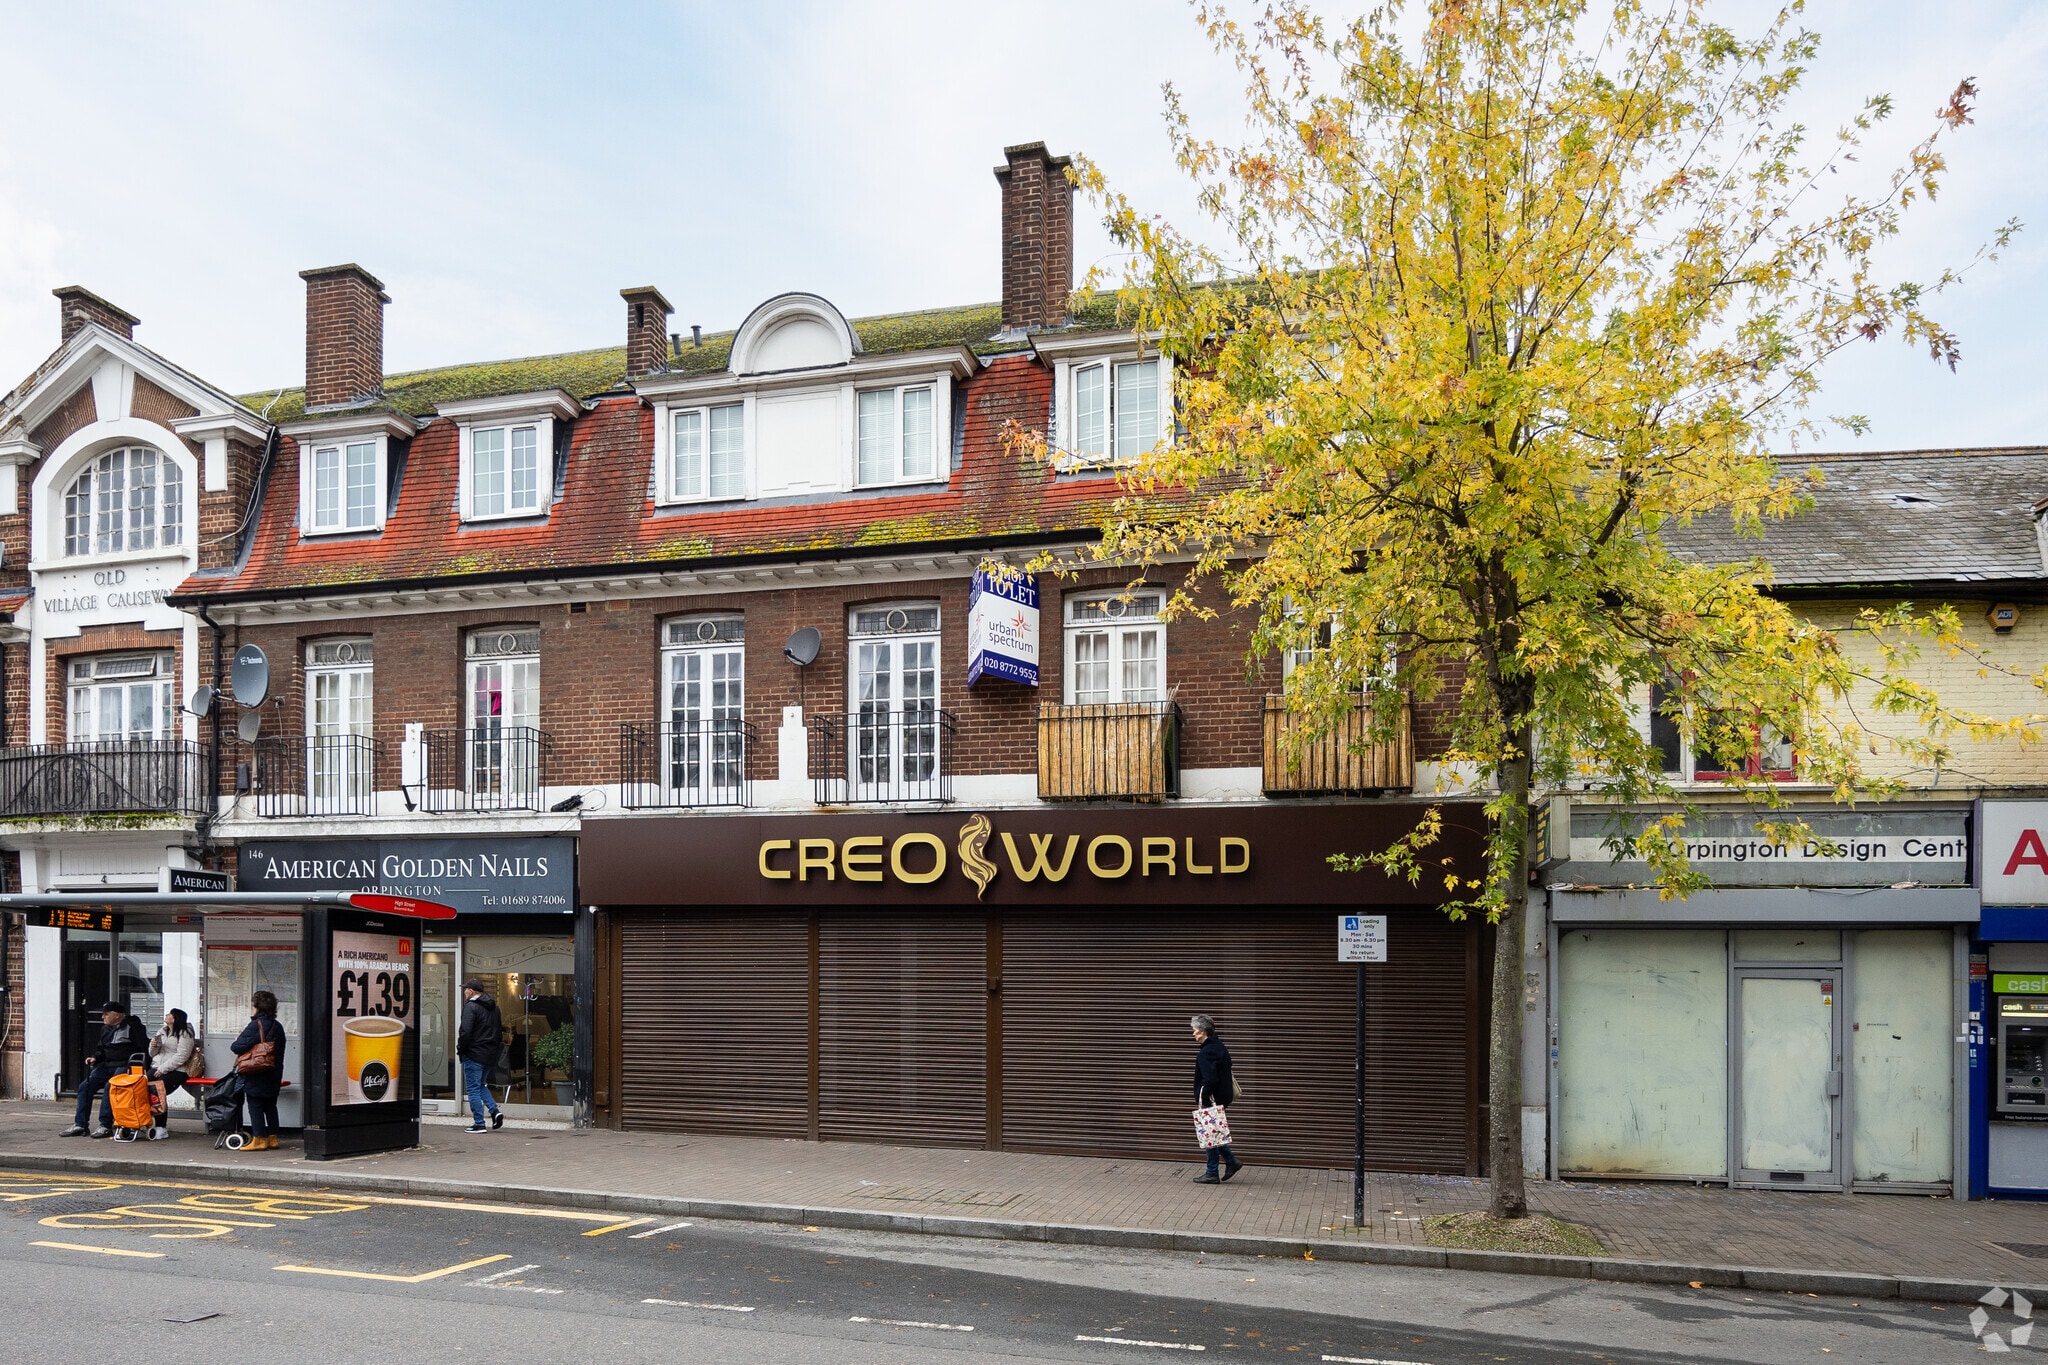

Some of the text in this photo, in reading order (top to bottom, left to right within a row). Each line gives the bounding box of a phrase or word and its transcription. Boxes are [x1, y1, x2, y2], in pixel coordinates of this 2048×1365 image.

[93, 569, 126, 586] OLD
[44, 588, 174, 613] VILLAGE CAUSEWA
[1010, 582, 1036, 606] LET
[988, 620, 1017, 638] urban
[988, 631, 1034, 654] spectrum
[984, 656, 1037, 680] 020 8772 9552
[249, 850, 264, 859] 146
[758, 832, 1250, 884] CREO WORLD
[1803, 839, 1887, 861] Design
[264, 854, 548, 879] AMERICAN GOLDEN NAILS
[174, 874, 225, 890] AMERICAN
[361, 886, 441, 896] ORPINGTON
[482, 896, 566, 905] Tel: 01689 874006
[338, 960, 409, 971] WITH 100% ARABICA BEANS
[344, 951, 357, 959] RICH
[358, 952, 388, 961] AMERICANO
[498, 957, 515, 966] bar
[337, 970, 410, 1018] £1.39
[38, 1193, 371, 1239] BUS
